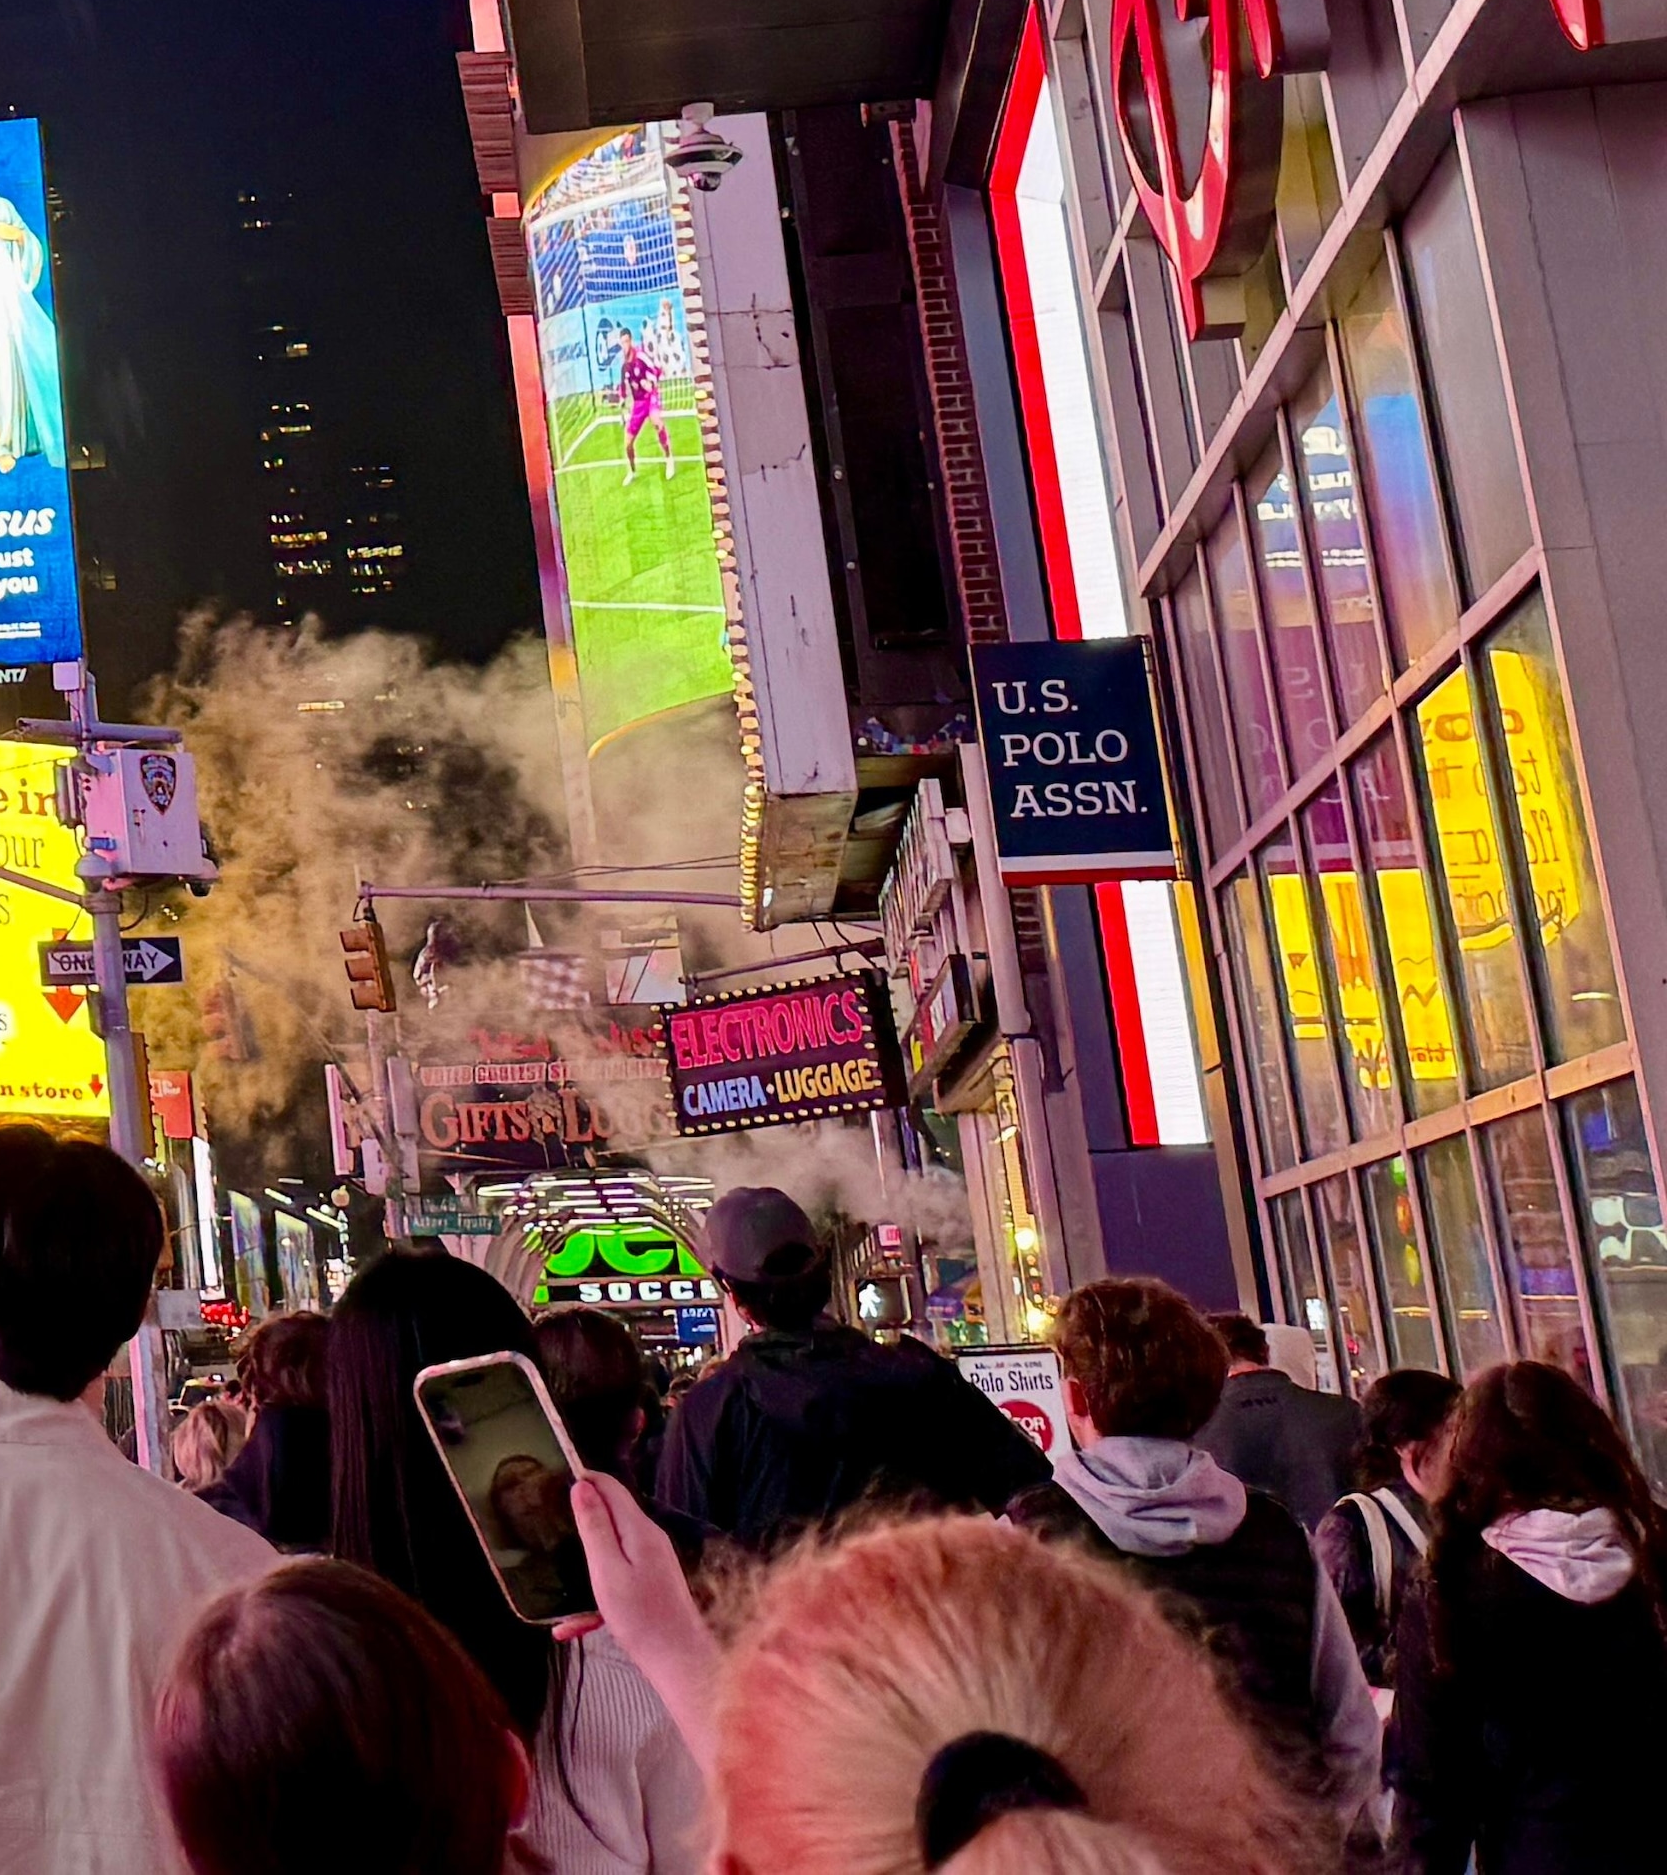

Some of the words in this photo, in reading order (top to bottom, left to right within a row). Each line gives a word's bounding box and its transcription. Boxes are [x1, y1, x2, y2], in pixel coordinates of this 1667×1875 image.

[993, 679, 1078, 715] U.S.
[1000, 729, 1128, 767] POLO
[1011, 780, 1148, 818] ASSN.
[673, 991, 862, 1069] ELECTRONICS
[17, 1082, 83, 1100] store
[683, 1081, 766, 1118] CAMERA
[776, 1061, 873, 1103] LUGGAGE
[420, 1092, 530, 1149] GIFTS
[970, 1372, 1004, 1392] Polo
[1008, 1371, 1053, 1391] Shirts
